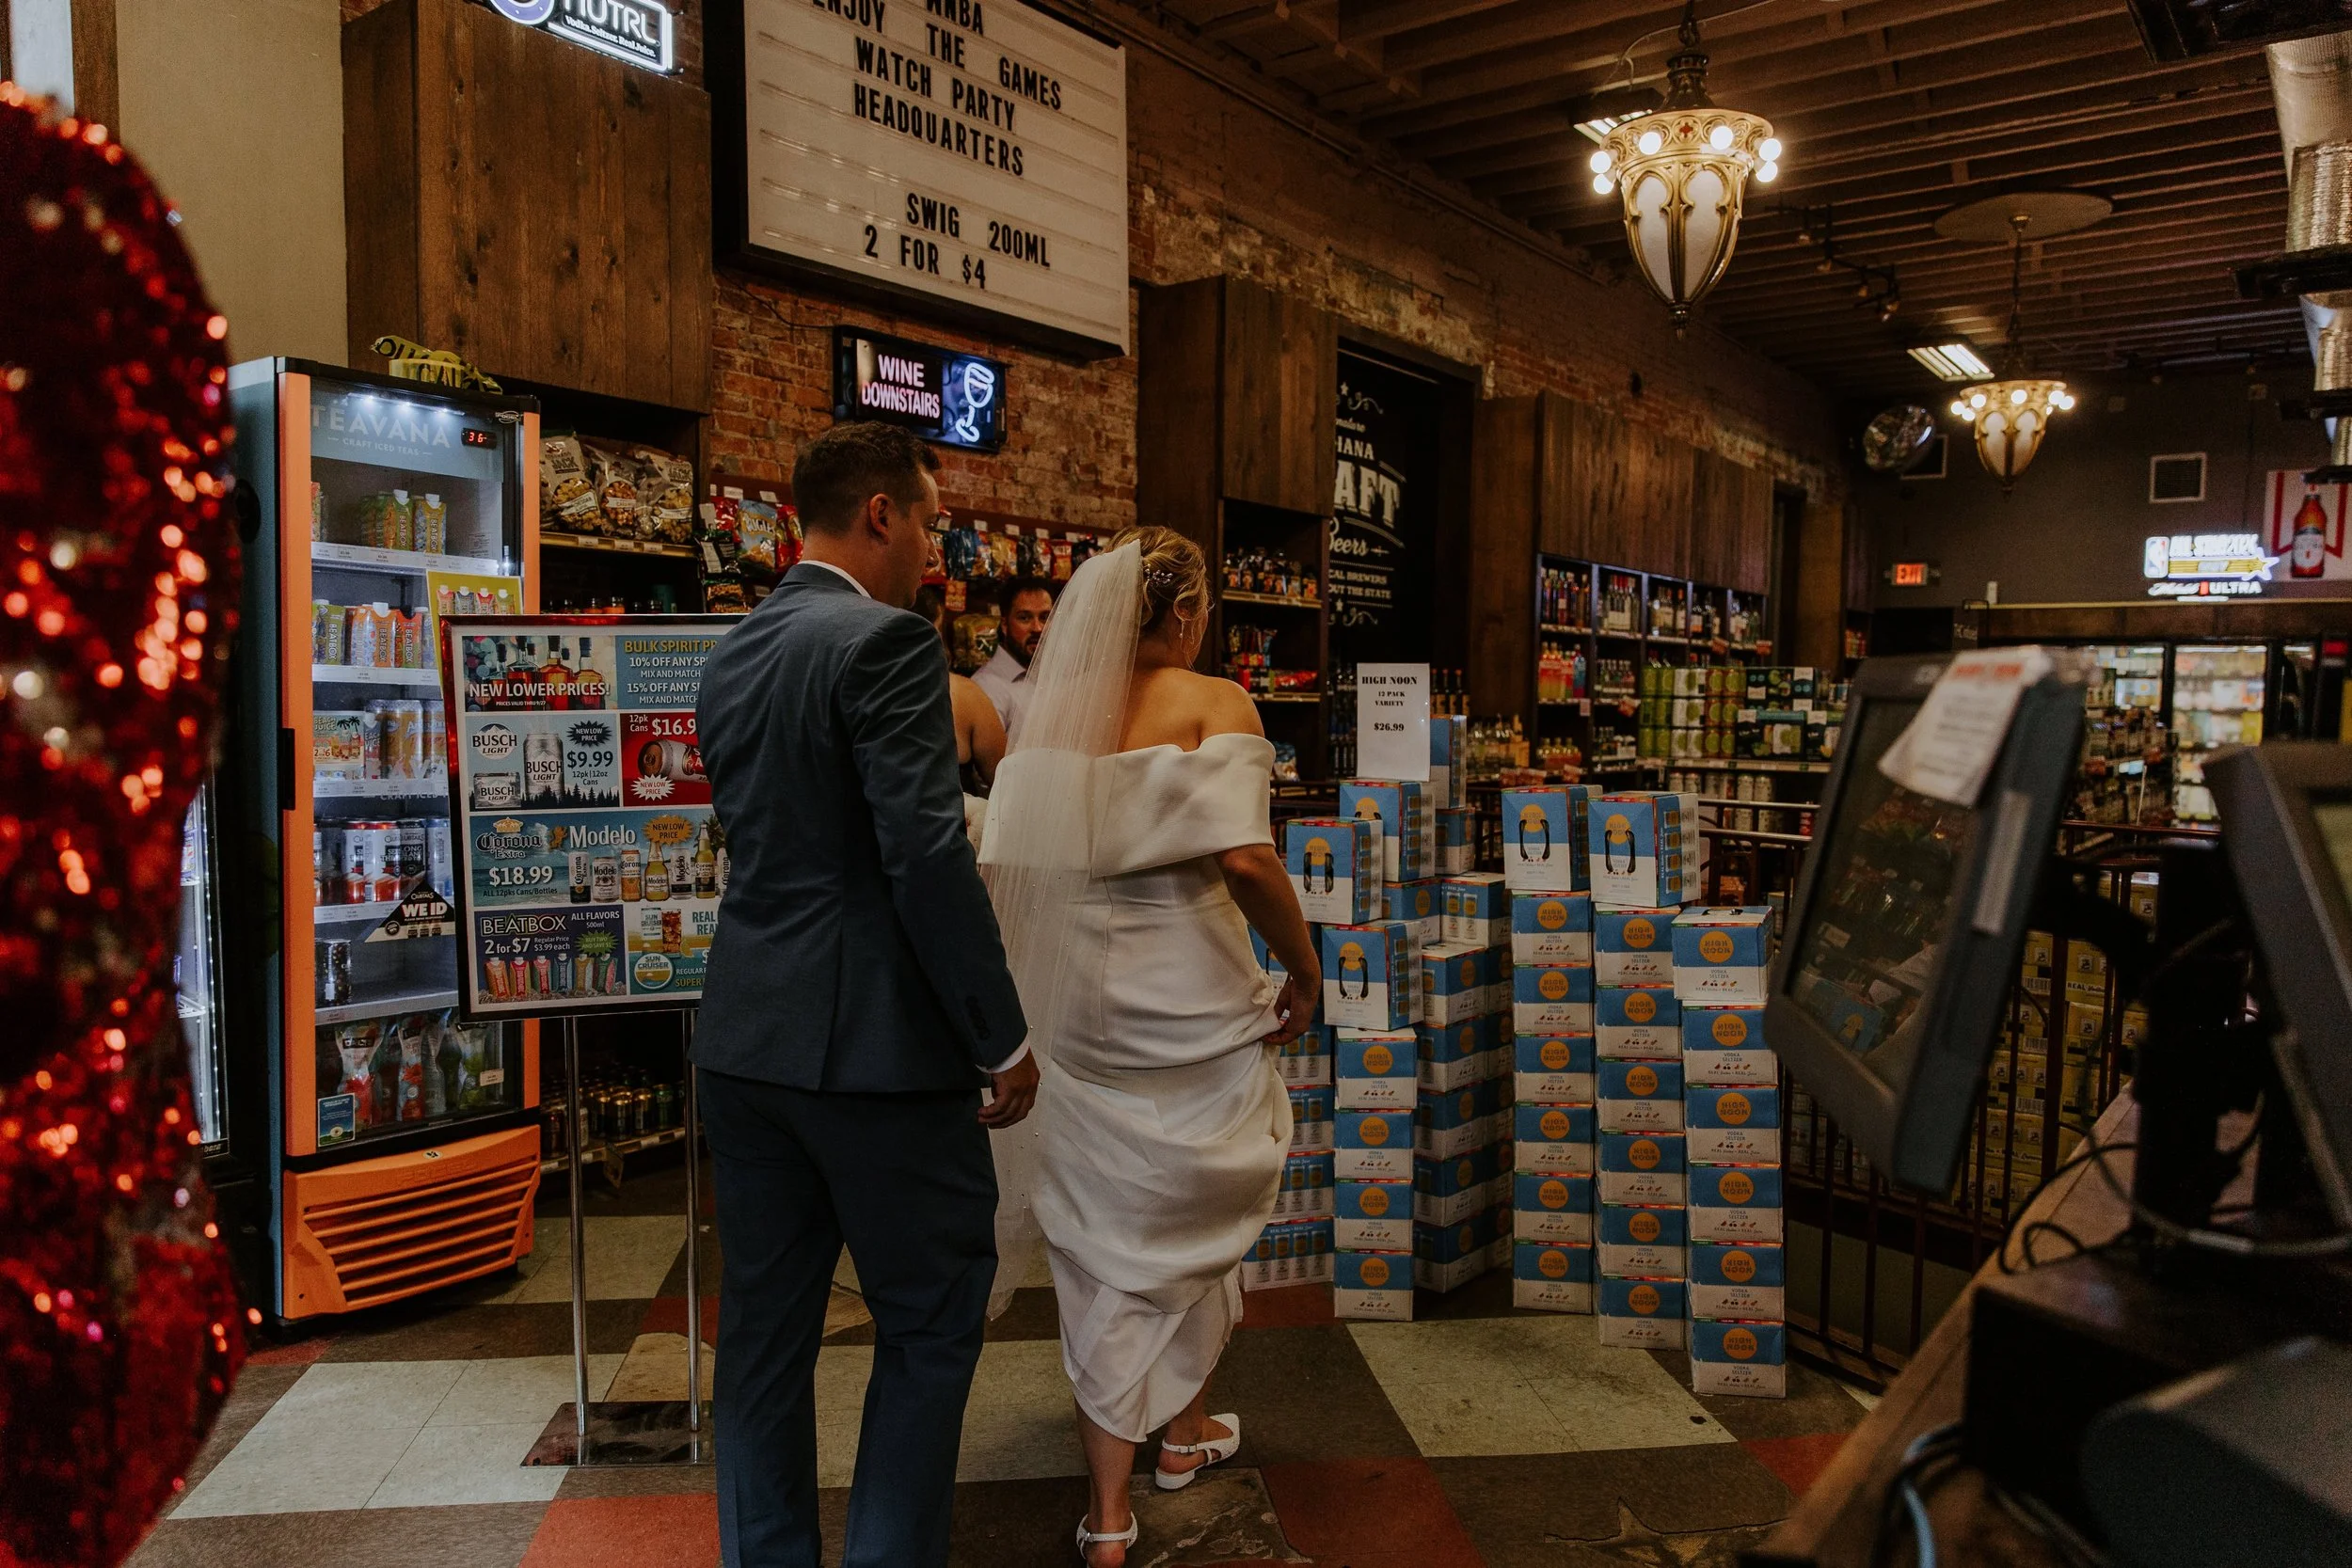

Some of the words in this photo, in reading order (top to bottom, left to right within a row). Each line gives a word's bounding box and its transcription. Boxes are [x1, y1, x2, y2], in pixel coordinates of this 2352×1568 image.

[926, 23, 965, 69] THE
[855, 37, 931, 98] WATCH
[952, 77, 1014, 132] PARTY
[999, 56, 1061, 110] GAMES
[854, 83, 1023, 176] HEADQUARTERS
[906, 193, 960, 238] SWIG
[989, 221, 1050, 267] 200ML
[865, 225, 879, 258] 2
[900, 234, 940, 275] FOR
[962, 255, 986, 289] $4
[878, 354, 926, 388] WINE
[861, 379, 941, 419] DOWNSTAIRS
[342, 437, 372, 449] CRAFT
[624, 641, 659, 653] BULK
[660, 641, 701, 653] SPIRIT
[629, 657, 651, 667] 10%
[652, 657, 672, 667] OFF
[672, 657, 692, 667] ANY
[694, 657, 708, 666] SP
[1361, 676, 1387, 685] HIGH
[1390, 676, 1418, 685] NOON
[470, 684, 502, 697] NEW
[506, 683, 556, 697] LOWER
[560, 682, 611, 696] PRICES!
[628, 683, 648, 693] 15%
[649, 683, 668, 692] OFF
[670, 682, 691, 692] ANY
[629, 715, 648, 723] 12pk
[1374, 722, 1405, 731] $26.99
[472, 735, 517, 747] BUSCH
[567, 751, 613, 768] $9.99
[527, 761, 563, 773] BUSCH
[481, 786, 515, 797] BUSCH
[475, 832, 543, 852] Corona
[569, 824, 636, 847] Modelo
[495, 848, 526, 859] Extra
[489, 866, 553, 887] $18.99
[402, 904, 427, 918] WE
[430, 902, 448, 916] ID
[571, 912, 585, 921] ALL
[586, 911, 620, 920] FLAVORS
[692, 911, 715, 922] REAL
[482, 915, 567, 935] BEATBOX
[697, 924, 718, 935] REA
[485, 940, 495, 955] 2
[497, 943, 511, 954] for
[513, 937, 531, 954] $7
[534, 943, 552, 952] $3.99
[553, 942, 570, 951] each
[675, 978, 701, 987] SUPER
